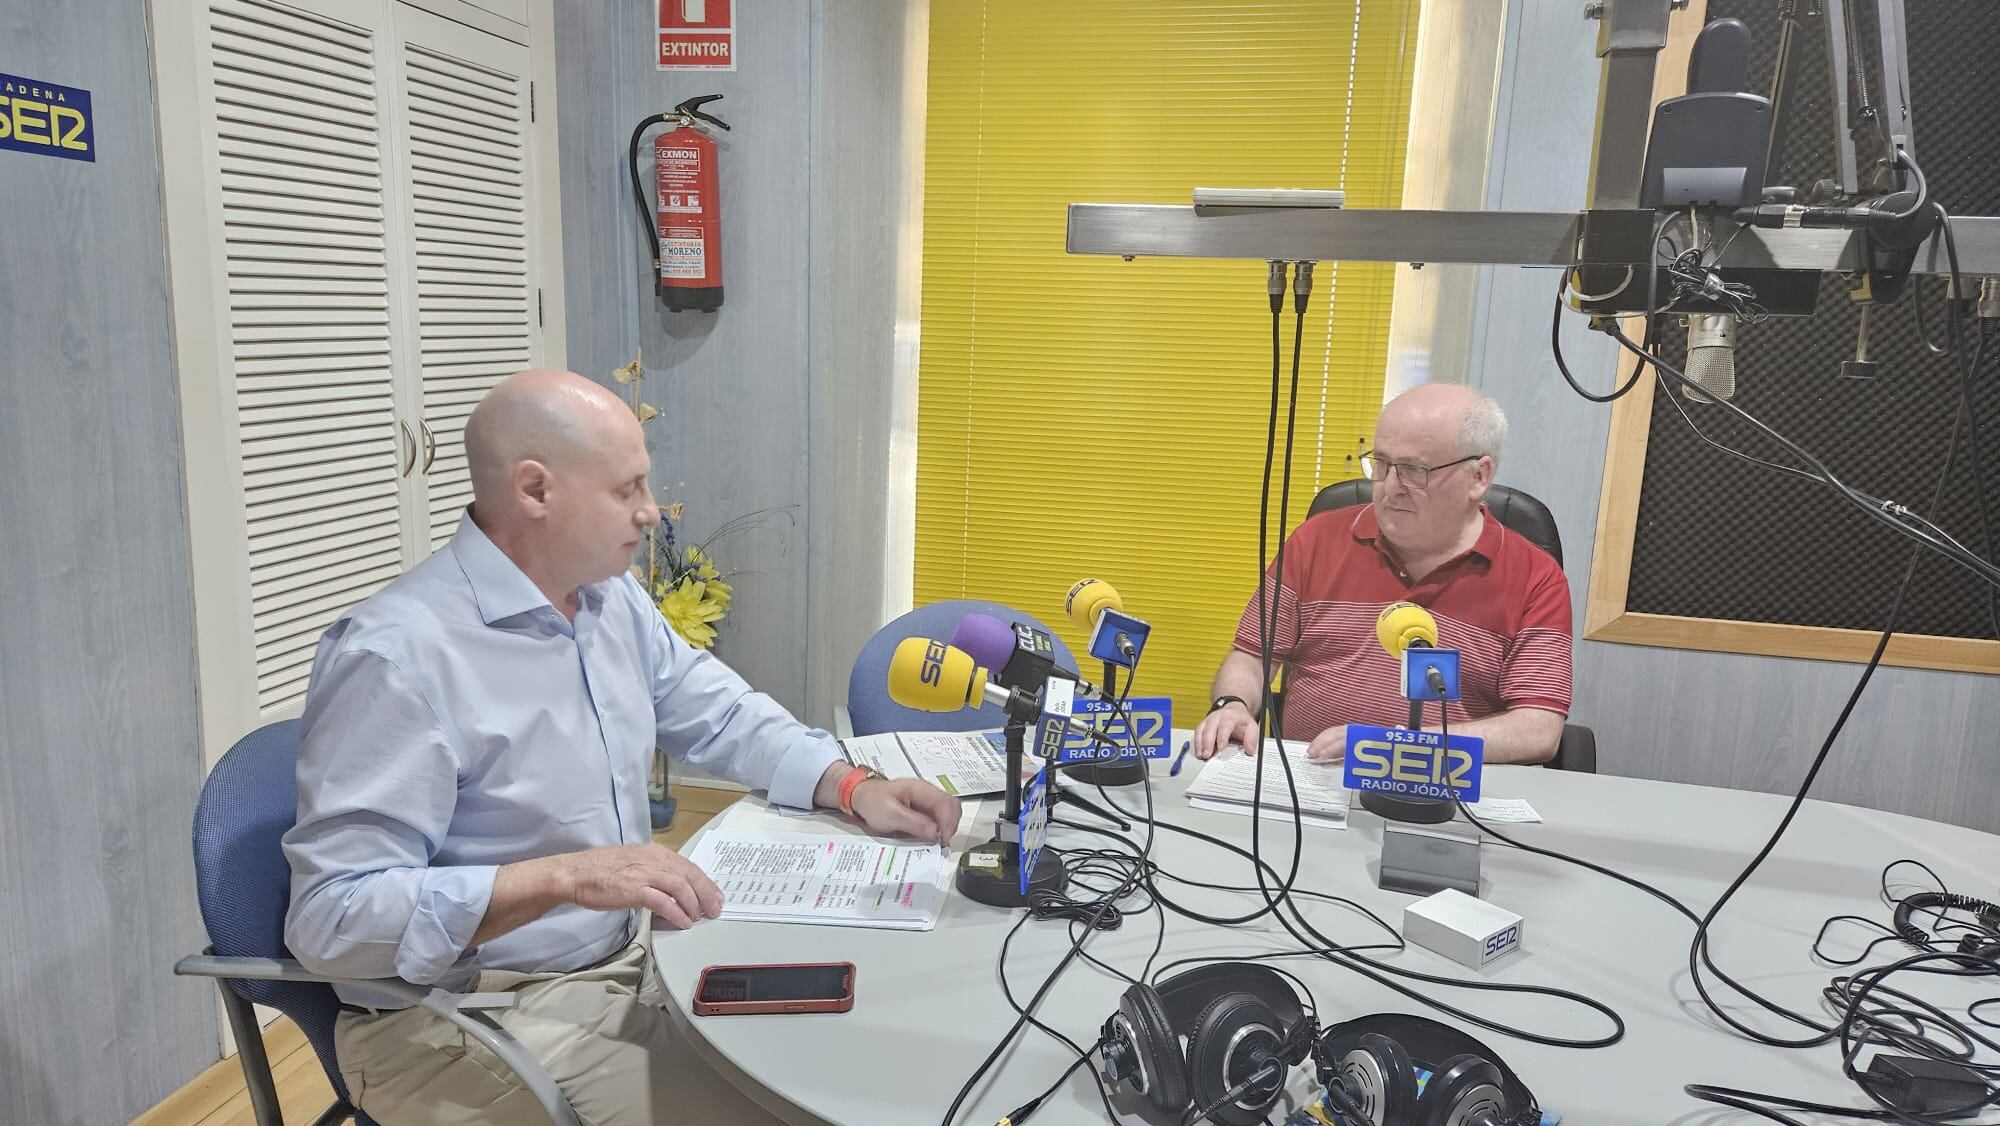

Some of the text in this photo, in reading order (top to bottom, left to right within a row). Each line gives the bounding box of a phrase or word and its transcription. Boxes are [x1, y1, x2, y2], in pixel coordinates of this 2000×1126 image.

[661, 42, 729, 57] EXTINTOR
[3, 82, 65, 102] ADENA
[661, 150, 697, 160] EXMON
[668, 247, 702, 256] MORENO
[1086, 702, 1111, 712] 95.3
[1040, 718, 1065, 760] SER
[1385, 731, 1439, 745] 95.3 FM
[1117, 746, 1156, 759] ÓDAR
[1352, 739, 1473, 789] SER
[1361, 779, 1462, 800] RADIO JÓDAR
[1486, 926, 1517, 957] SER
